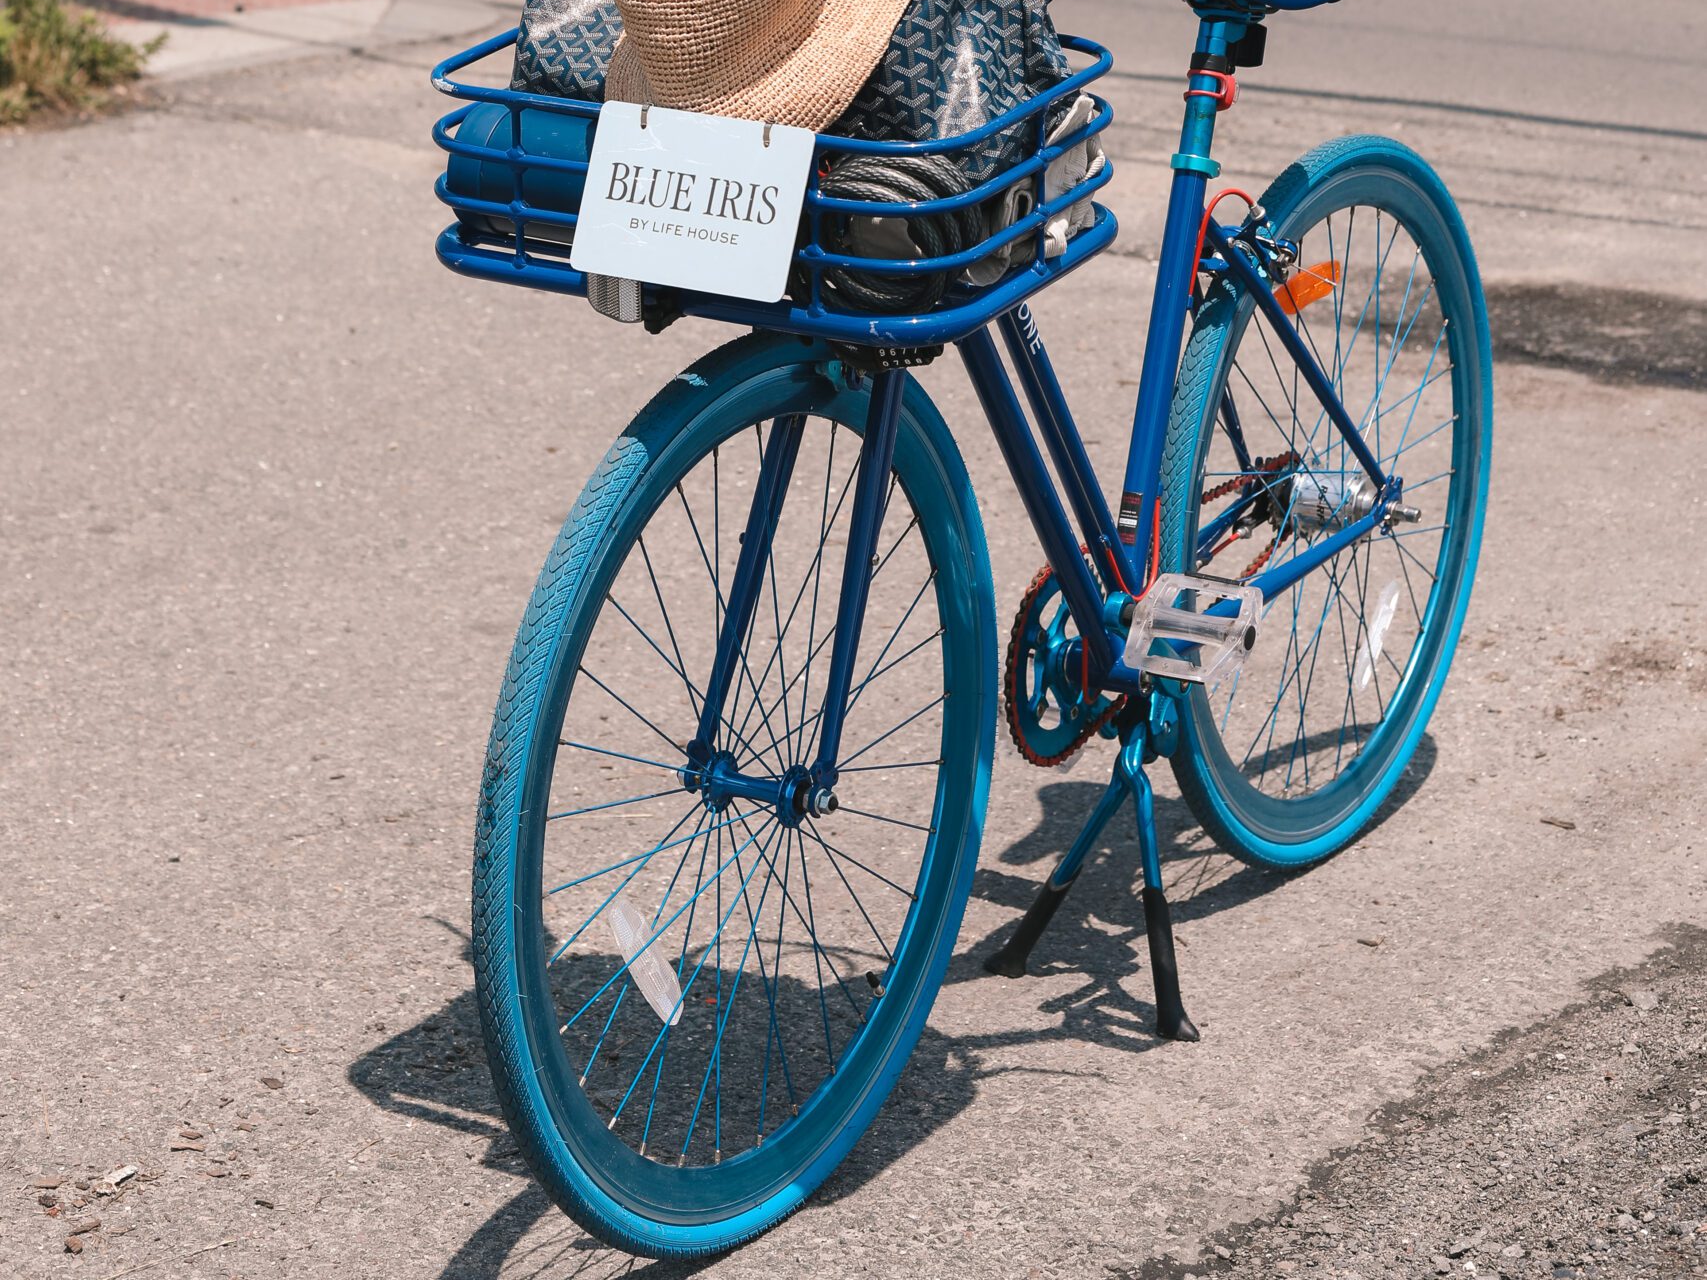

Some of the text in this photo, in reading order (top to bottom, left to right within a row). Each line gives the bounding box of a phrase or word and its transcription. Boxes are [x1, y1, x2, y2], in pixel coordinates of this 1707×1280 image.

[605, 162, 779, 225] BLUE IRIS
[629, 217, 740, 246] BY LIFE HOUSE
